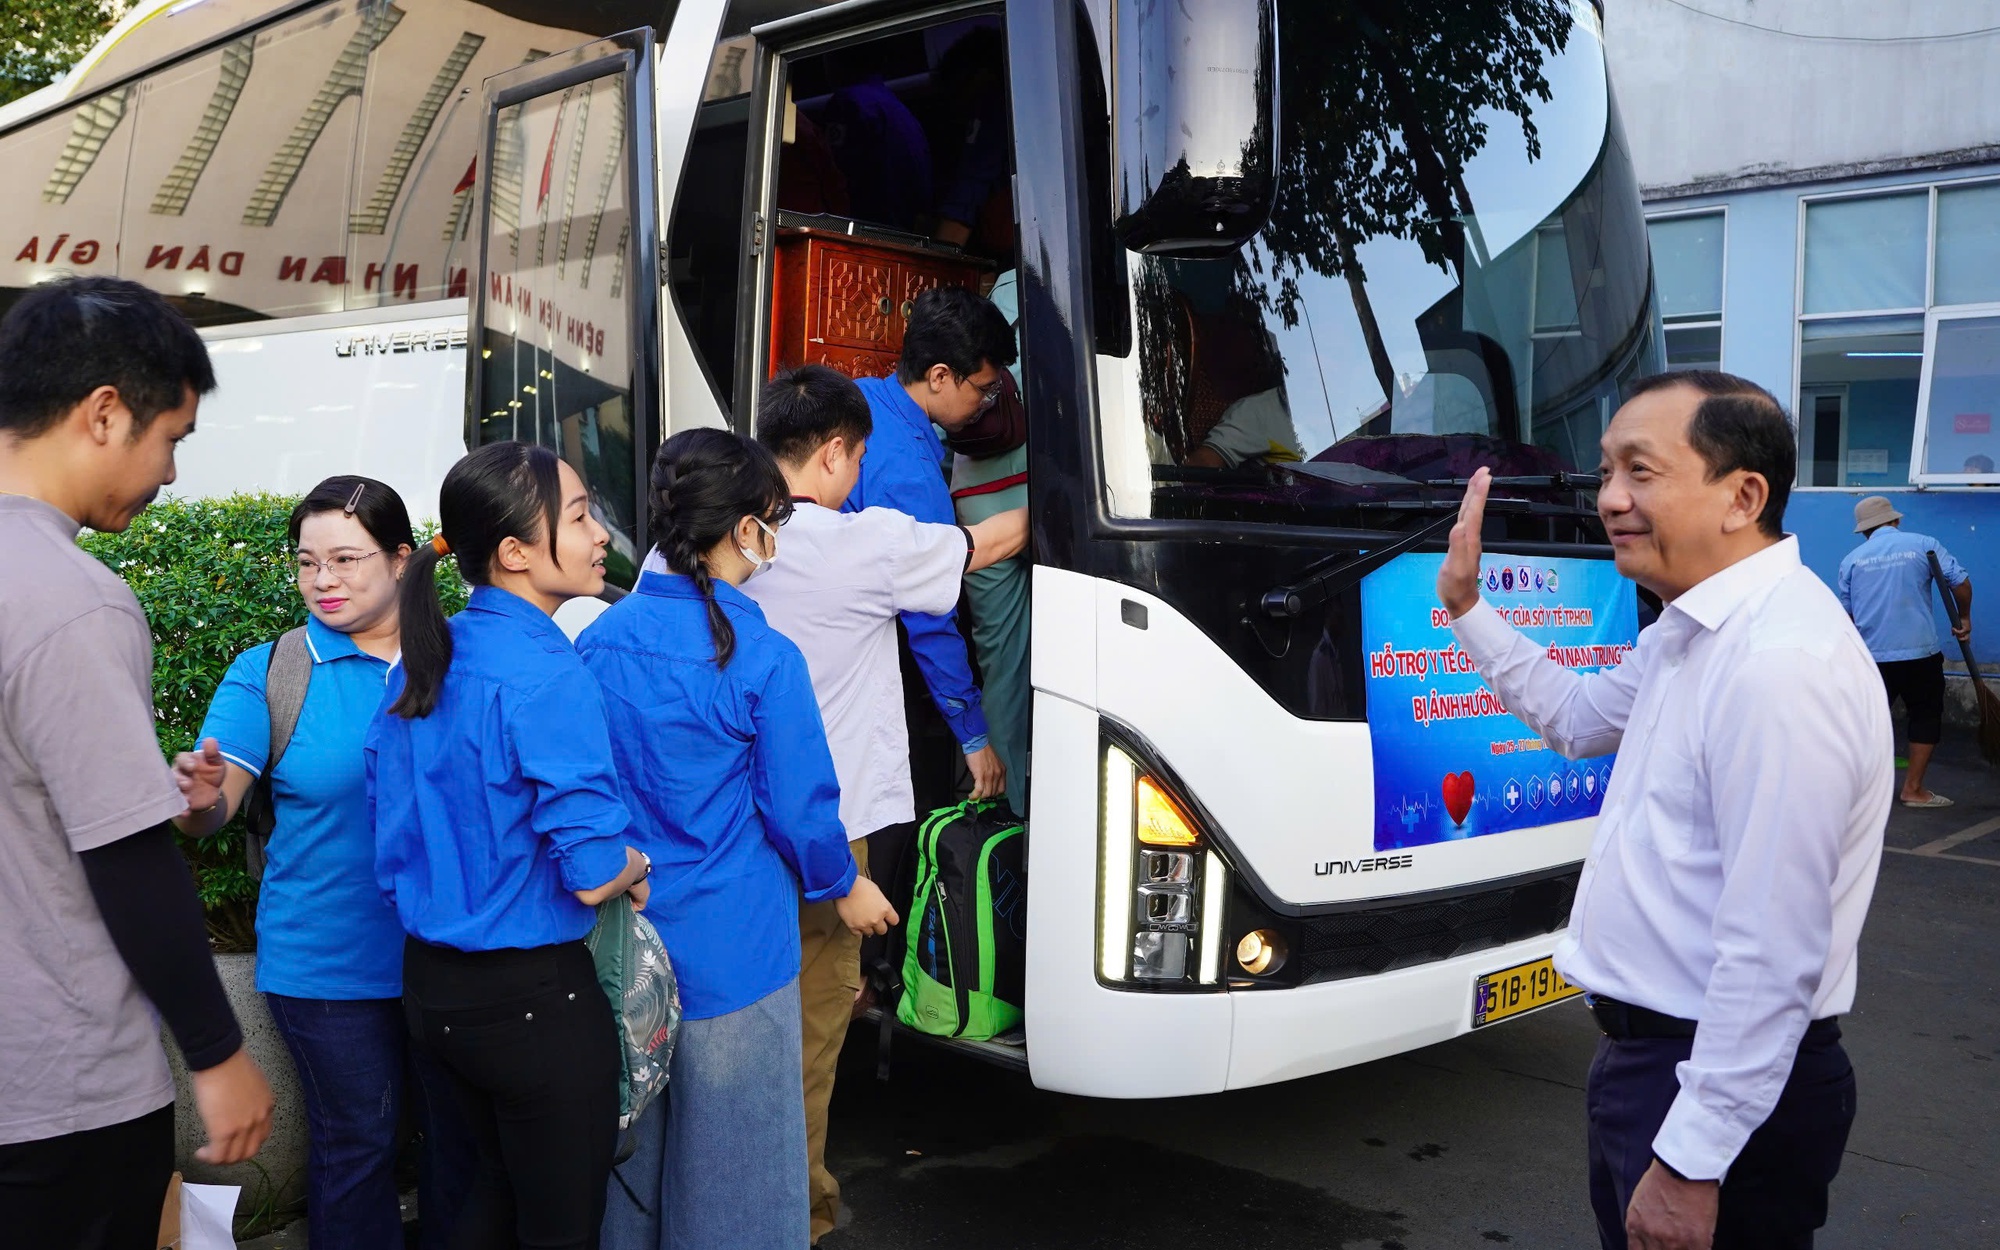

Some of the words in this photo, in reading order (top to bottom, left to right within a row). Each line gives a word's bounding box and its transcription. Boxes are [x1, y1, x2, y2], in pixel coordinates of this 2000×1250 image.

[335, 327, 467, 358] UNIVERSE
[1431, 608, 1451, 628] ĐO
[1512, 604, 1531, 626] CỦA
[1532, 603, 1545, 626] SỞ
[1545, 609, 1551, 626] Y
[1552, 603, 1564, 626] TẾ
[1371, 643, 1396, 677] HỖ
[1395, 649, 1428, 681] TRỢ
[1428, 651, 1438, 674] Y
[1440, 643, 1457, 673] TẾ
[1457, 650, 1476, 673] CH
[1565, 646, 1594, 668] NAM
[1592, 645, 1622, 667] TRUNG
[1413, 697, 1429, 727] BỊ
[1429, 689, 1460, 720] ẢNH
[1506, 740, 1515, 753] 25
[1315, 854, 1413, 876] UNIVERSE
[1487, 966, 1573, 1014] 51B-191.
